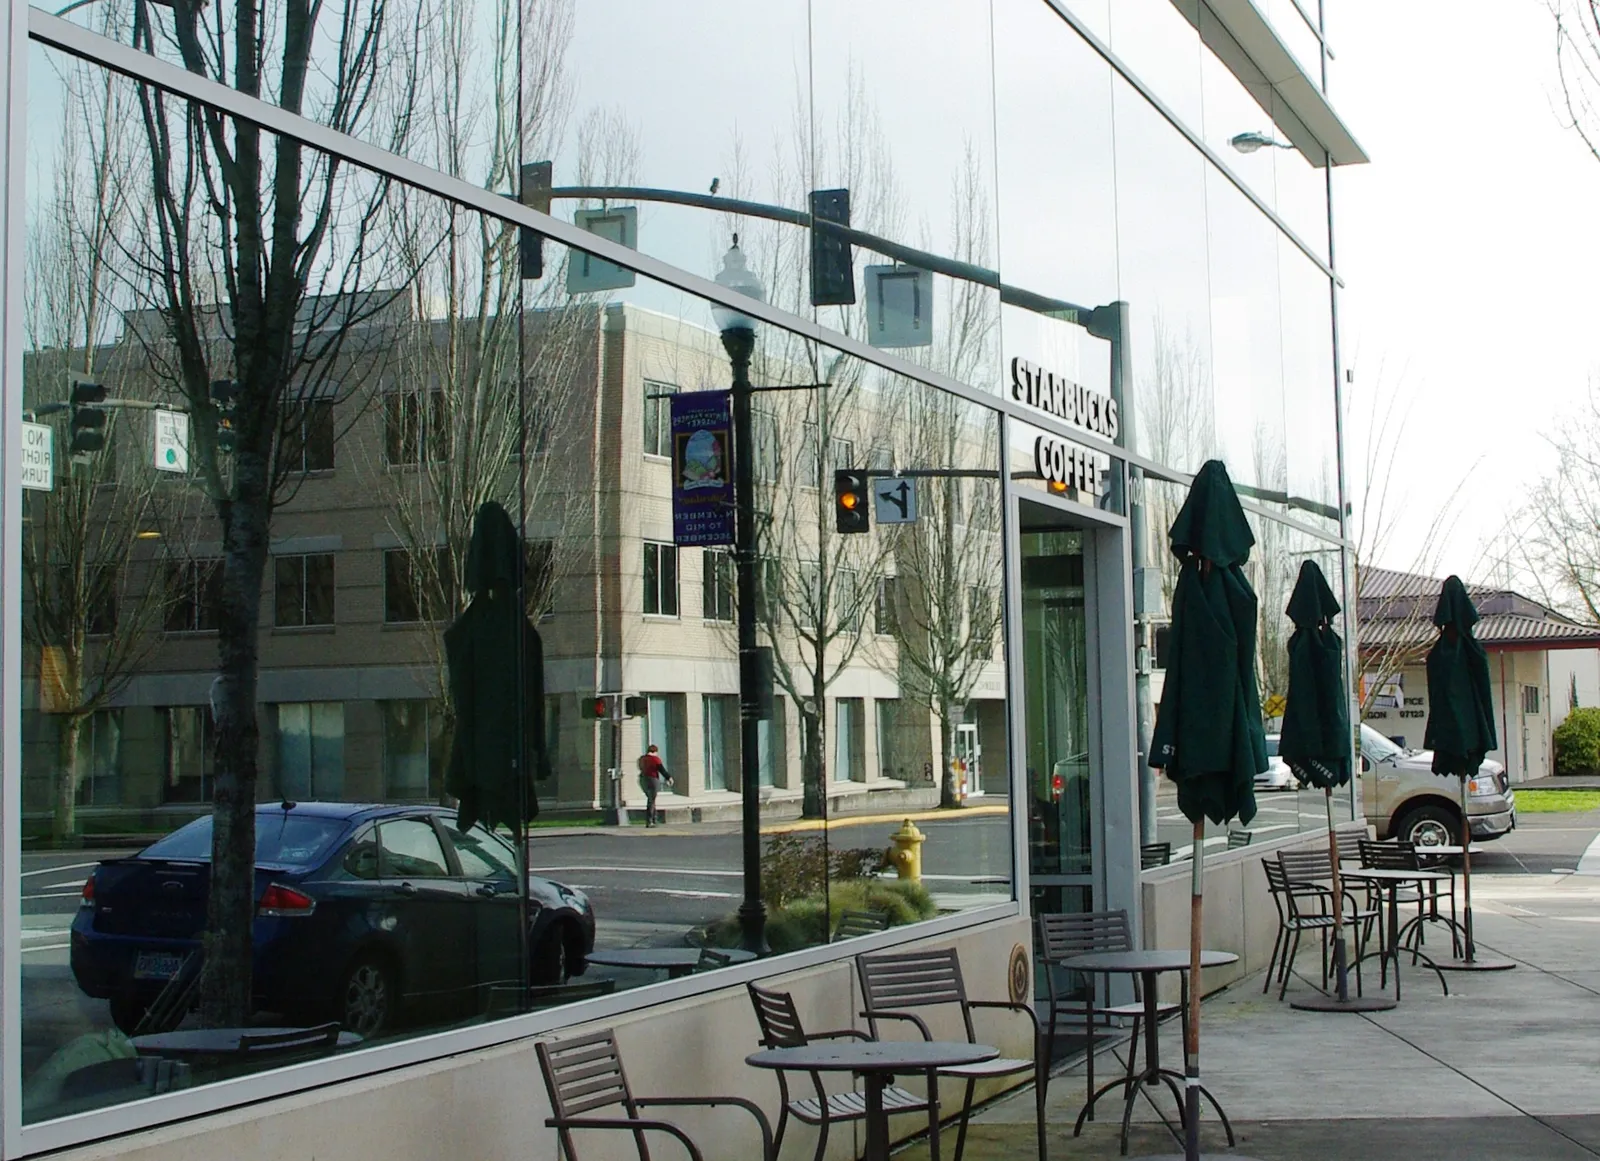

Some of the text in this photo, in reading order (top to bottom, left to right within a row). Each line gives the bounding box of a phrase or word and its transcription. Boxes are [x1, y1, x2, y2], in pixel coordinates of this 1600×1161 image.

[1011, 356, 1118, 439] STARBUCKS
[1034, 435, 1104, 497] COFFEE
[1400, 710, 1425, 718] 97123
